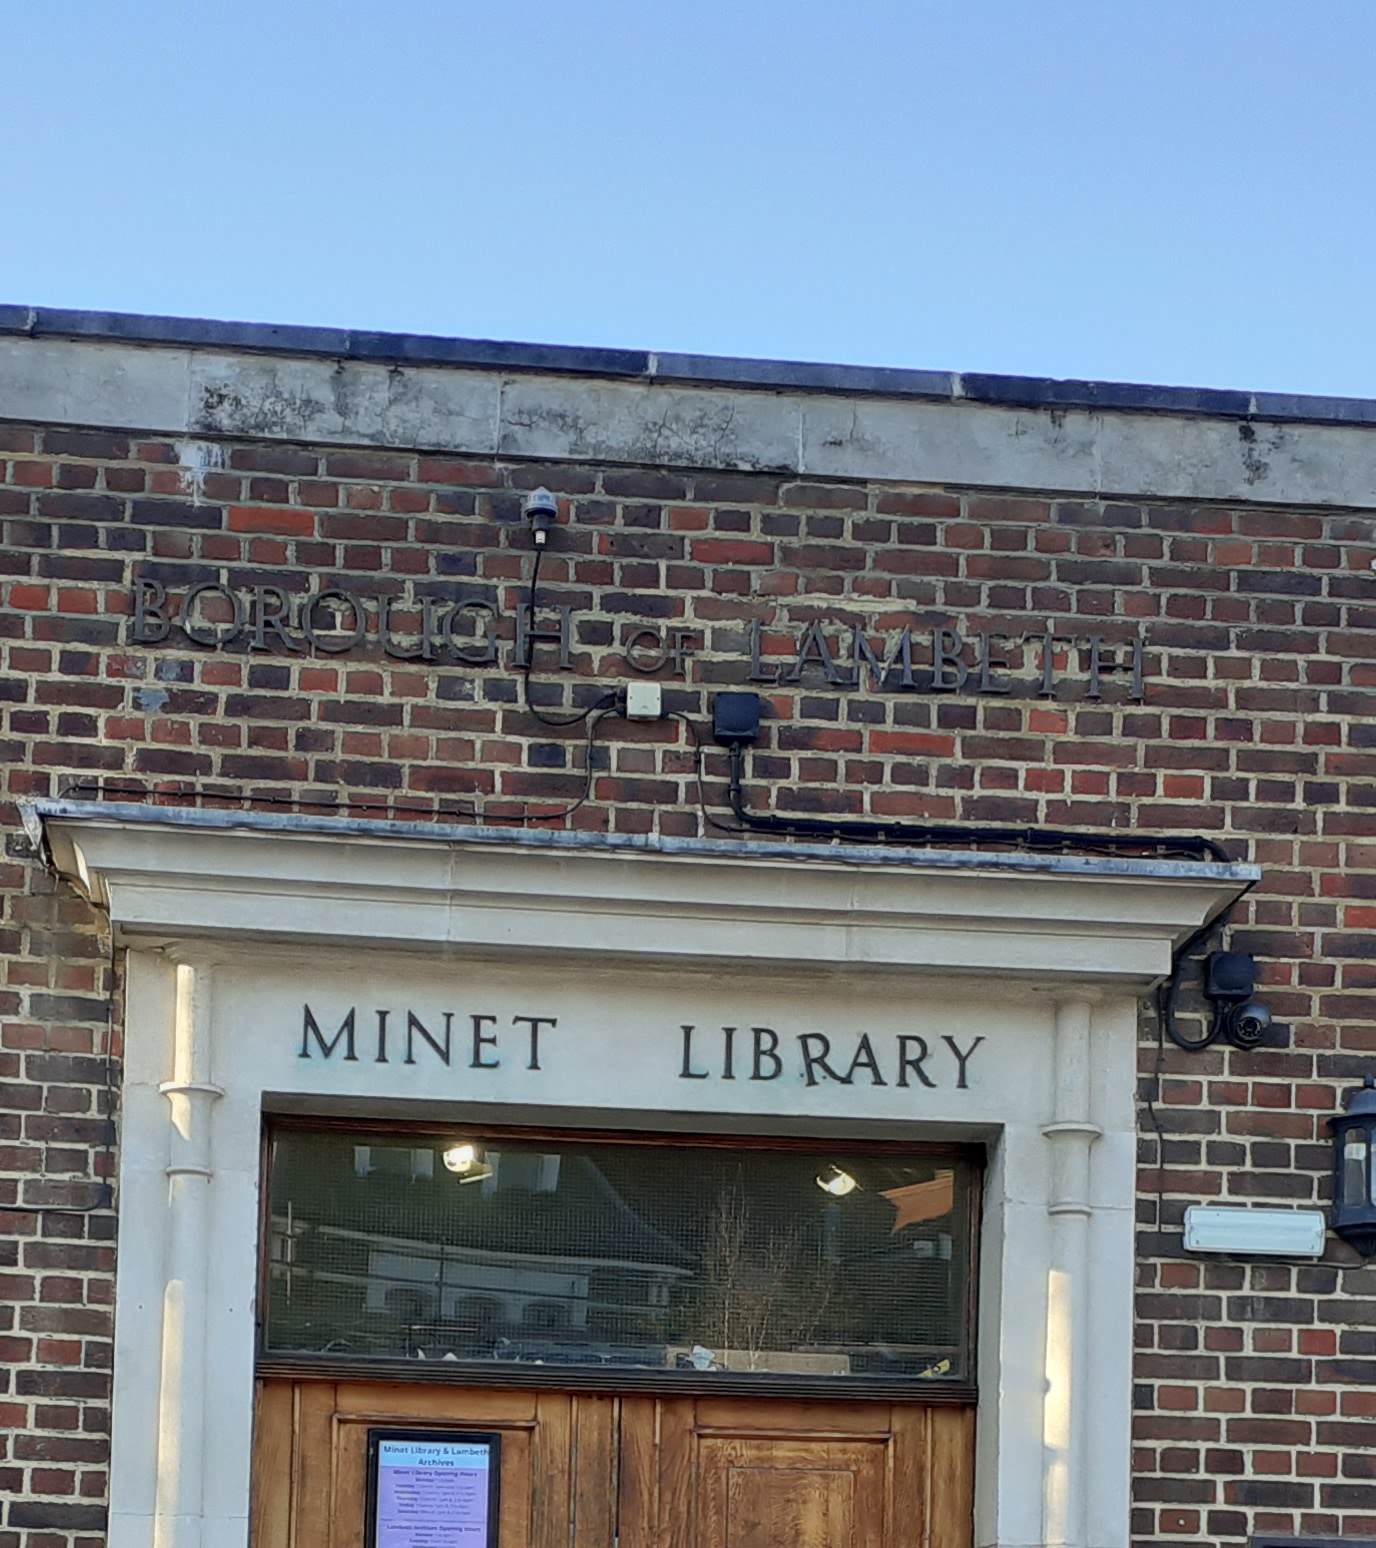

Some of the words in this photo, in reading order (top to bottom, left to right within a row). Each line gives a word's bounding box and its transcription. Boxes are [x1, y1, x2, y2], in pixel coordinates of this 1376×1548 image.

[132, 577, 573, 669] BOROUGH
[624, 627, 696, 676] OF
[746, 617, 1149, 700] LAMBETH
[297, 1003, 557, 1071] MINET
[679, 1024, 985, 1090] LIBRARY
[384, 1445, 408, 1454] Minet
[411, 1446, 441, 1456] Library
[443, 1447, 449, 1455] &
[452, 1447, 490, 1456] Lambeth
[418, 1458, 454, 1466] Archives
